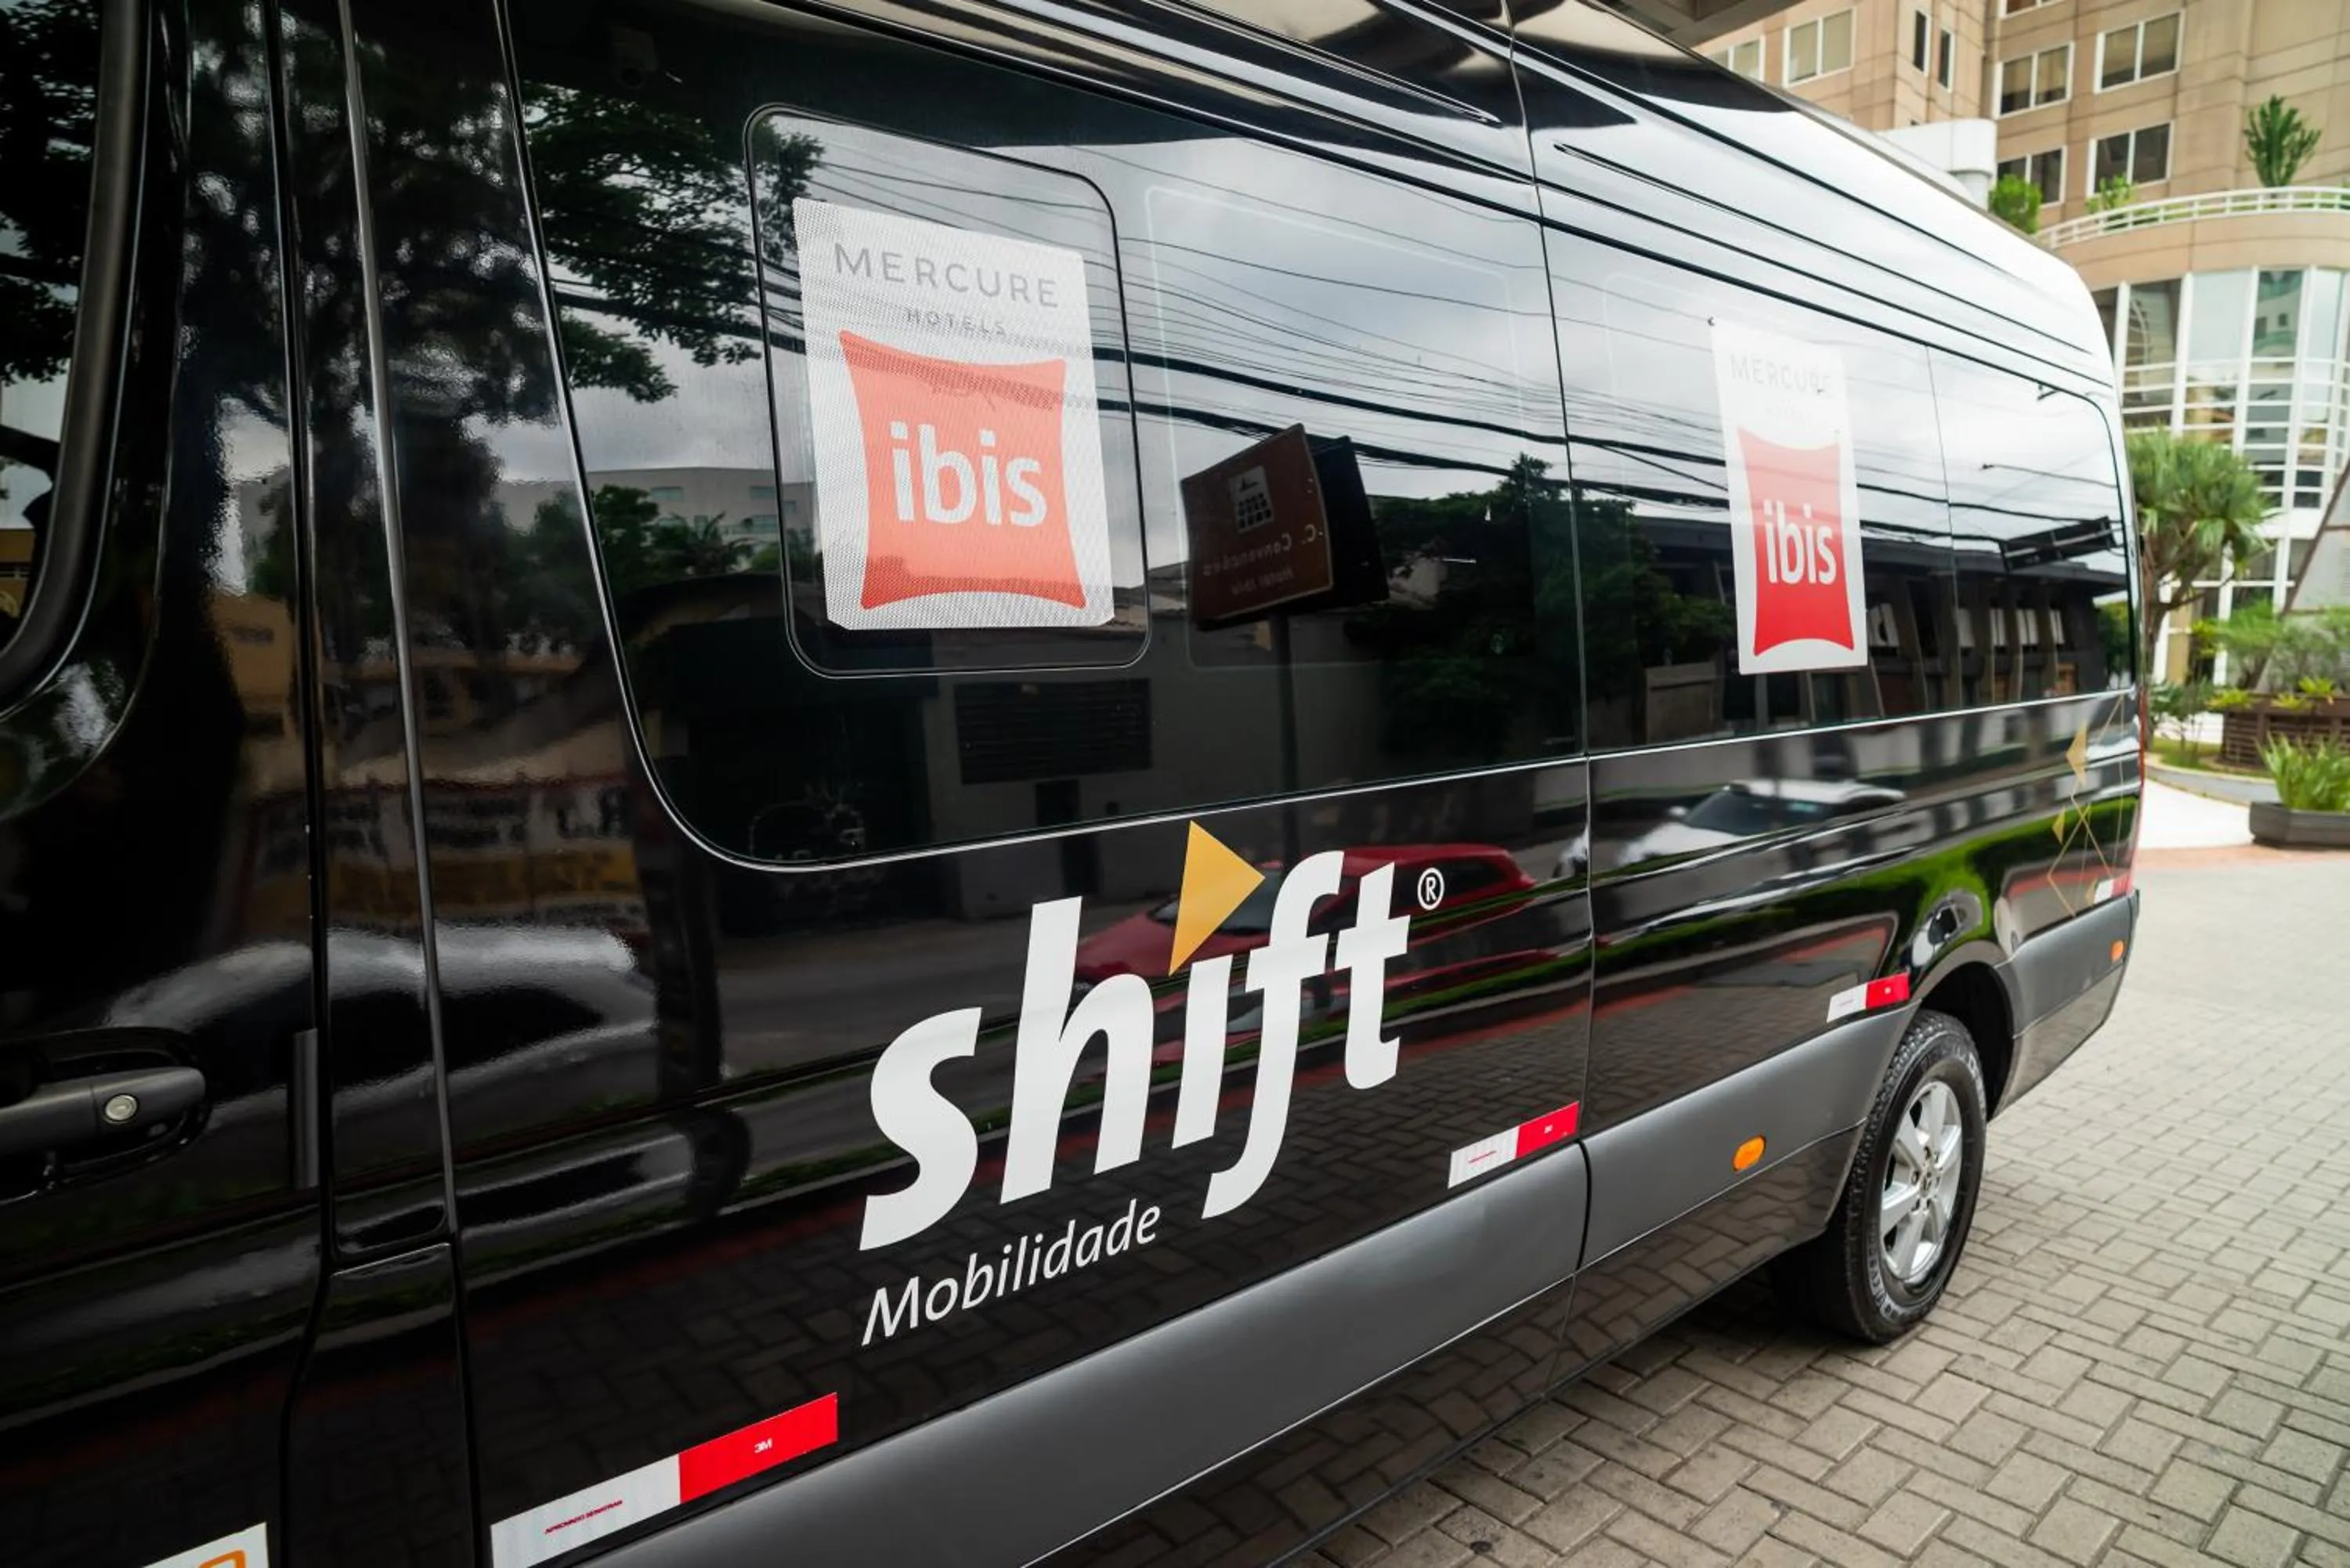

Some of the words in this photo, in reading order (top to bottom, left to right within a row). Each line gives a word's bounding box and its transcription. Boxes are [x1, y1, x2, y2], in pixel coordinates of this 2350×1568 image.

[833, 242, 1059, 309] MERCURE
[905, 306, 1007, 338] HOTELS
[890, 421, 1047, 527] ibis
[1763, 498, 1837, 585] ibis
[862, 1198, 1161, 1346] Mobilidade
[754, 1438, 774, 1454] 3M
